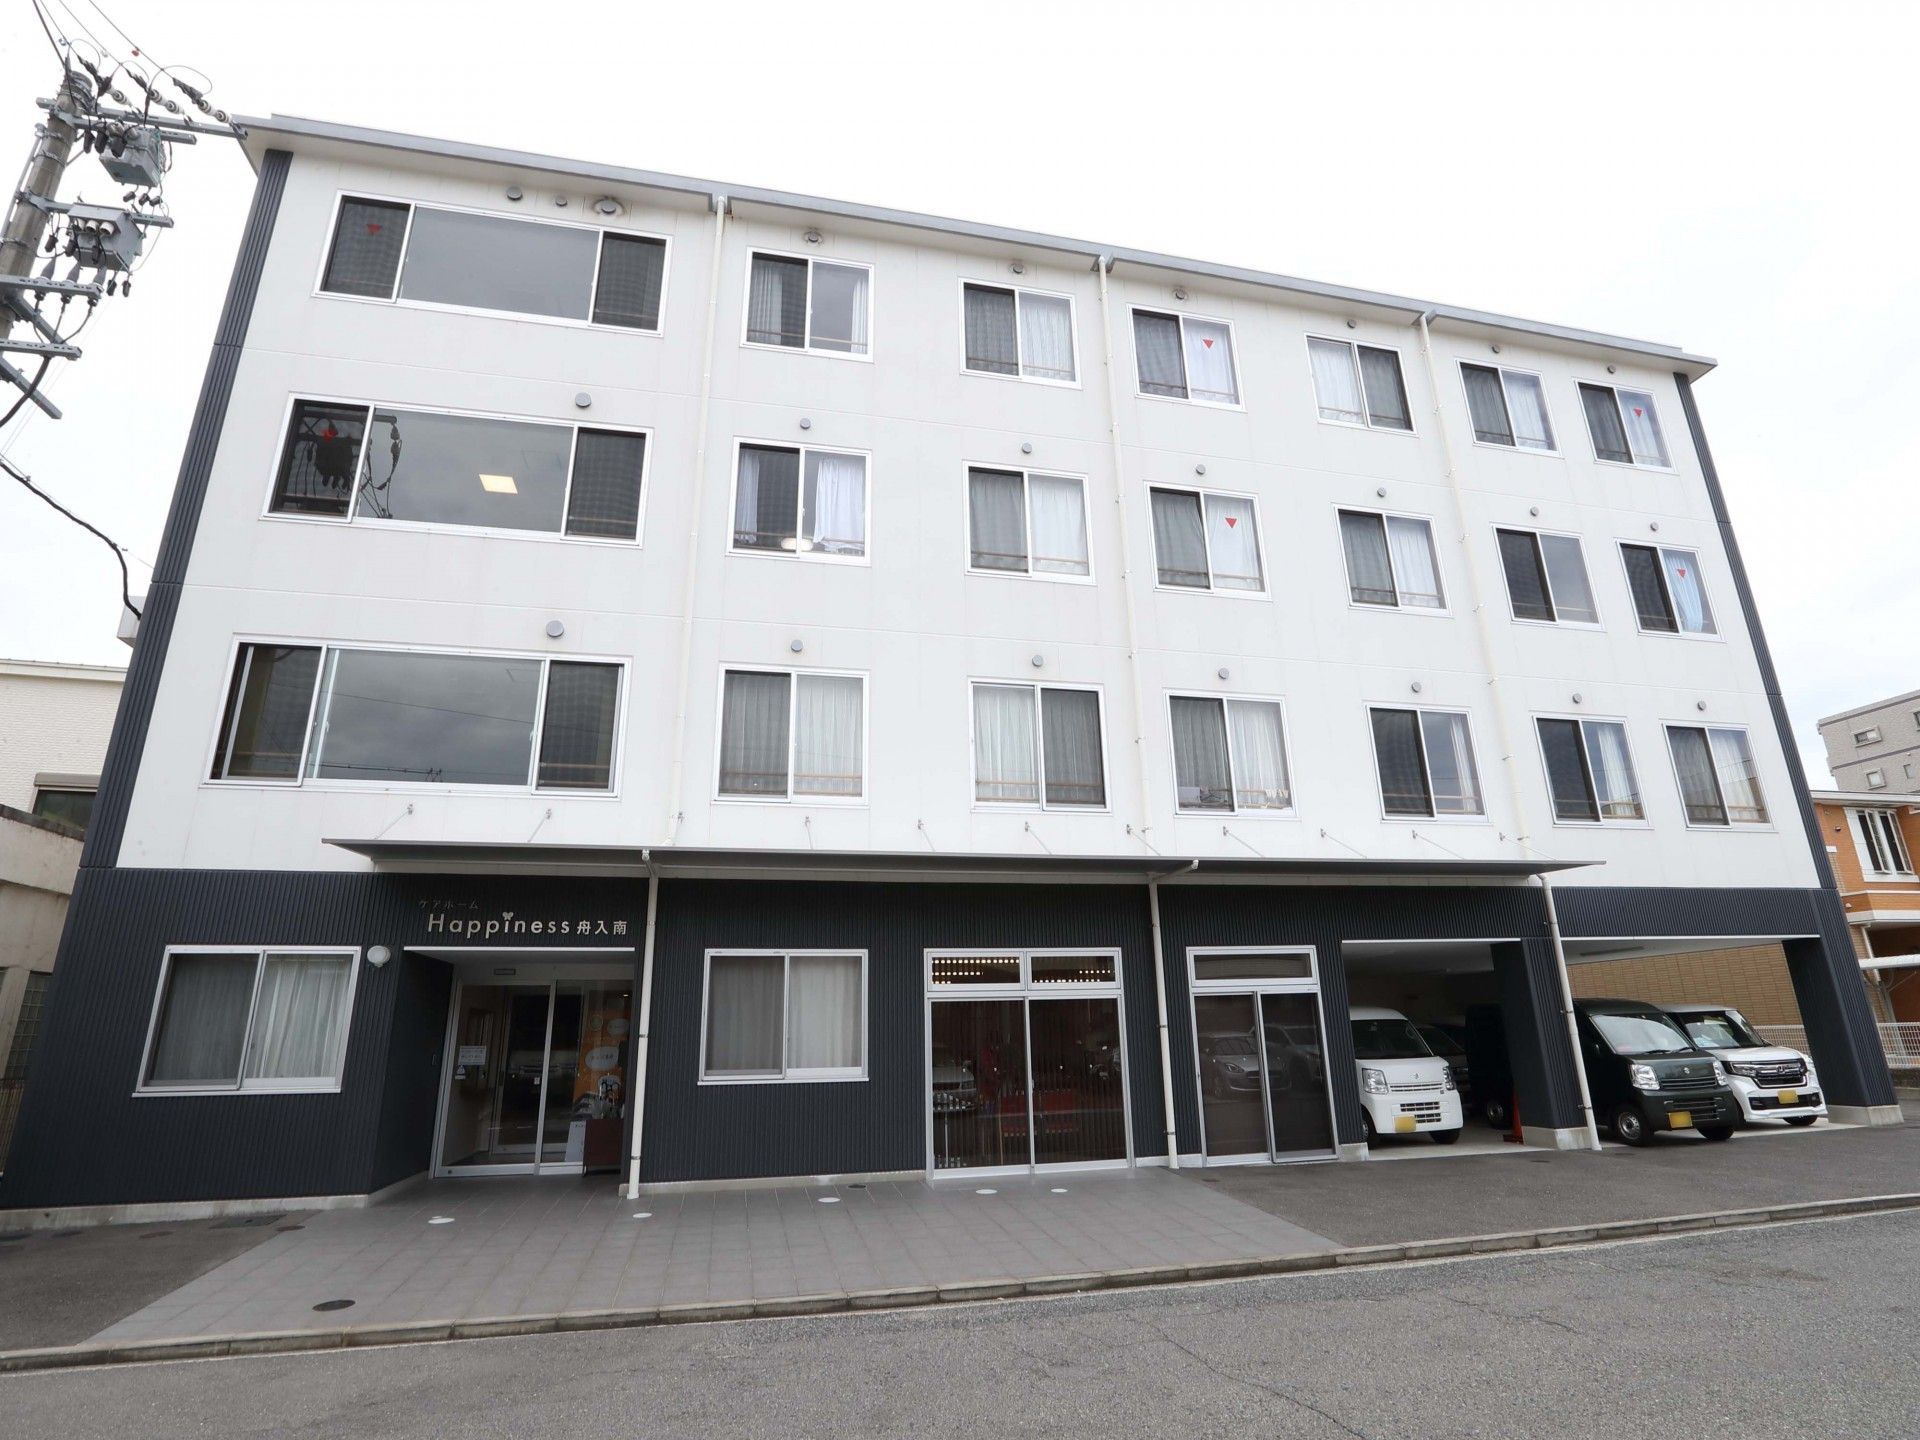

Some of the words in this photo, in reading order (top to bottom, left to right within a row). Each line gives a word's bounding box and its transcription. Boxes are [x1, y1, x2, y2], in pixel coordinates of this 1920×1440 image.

[427, 912, 570, 938] Happiness
[576, 920, 628, 935] 舟入南
